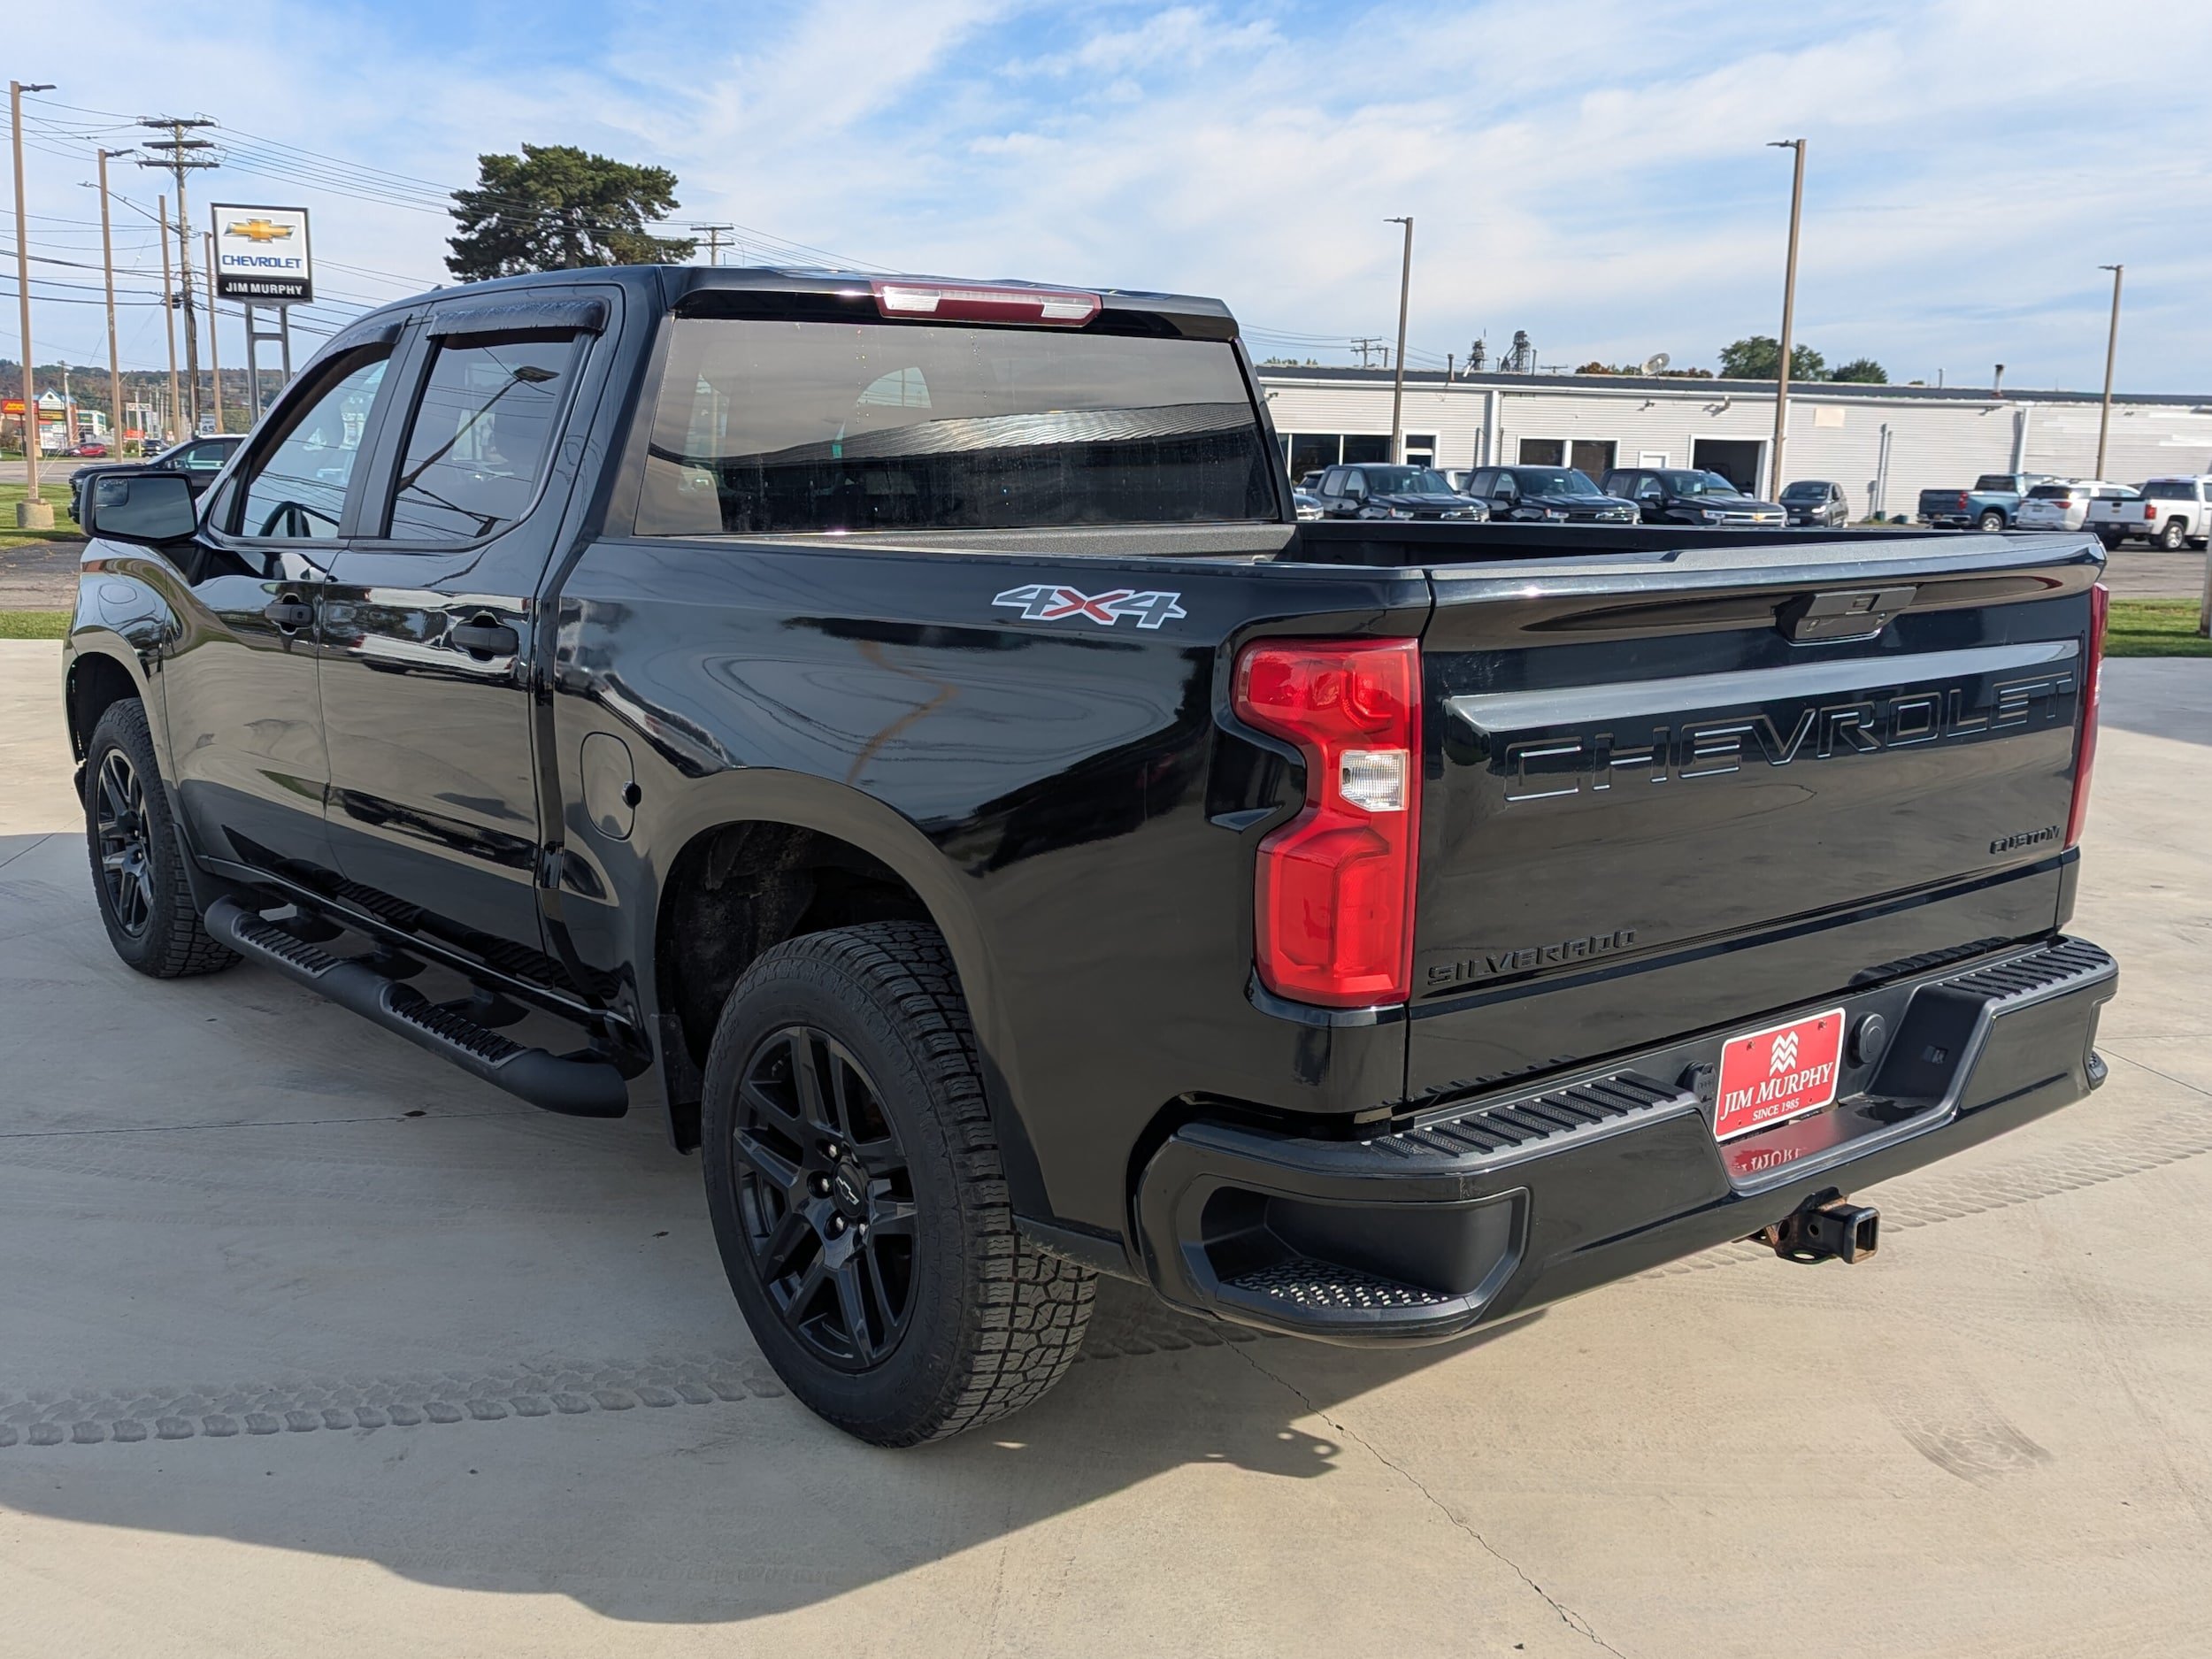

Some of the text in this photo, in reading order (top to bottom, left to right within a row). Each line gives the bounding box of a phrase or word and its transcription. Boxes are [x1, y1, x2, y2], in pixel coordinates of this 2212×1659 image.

[222, 255, 302, 269] CHEVROLET
[226, 282, 303, 295] JIM MURPHY
[1506, 671, 2073, 802] CHEVROLET
[1989, 826, 2060, 854] CUSTOM
[1427, 929, 1636, 986] SILVERADO
[1720, 1062, 1833, 1121] JIM MURPHY
[1752, 1097, 1801, 1121] SINCE 1985
